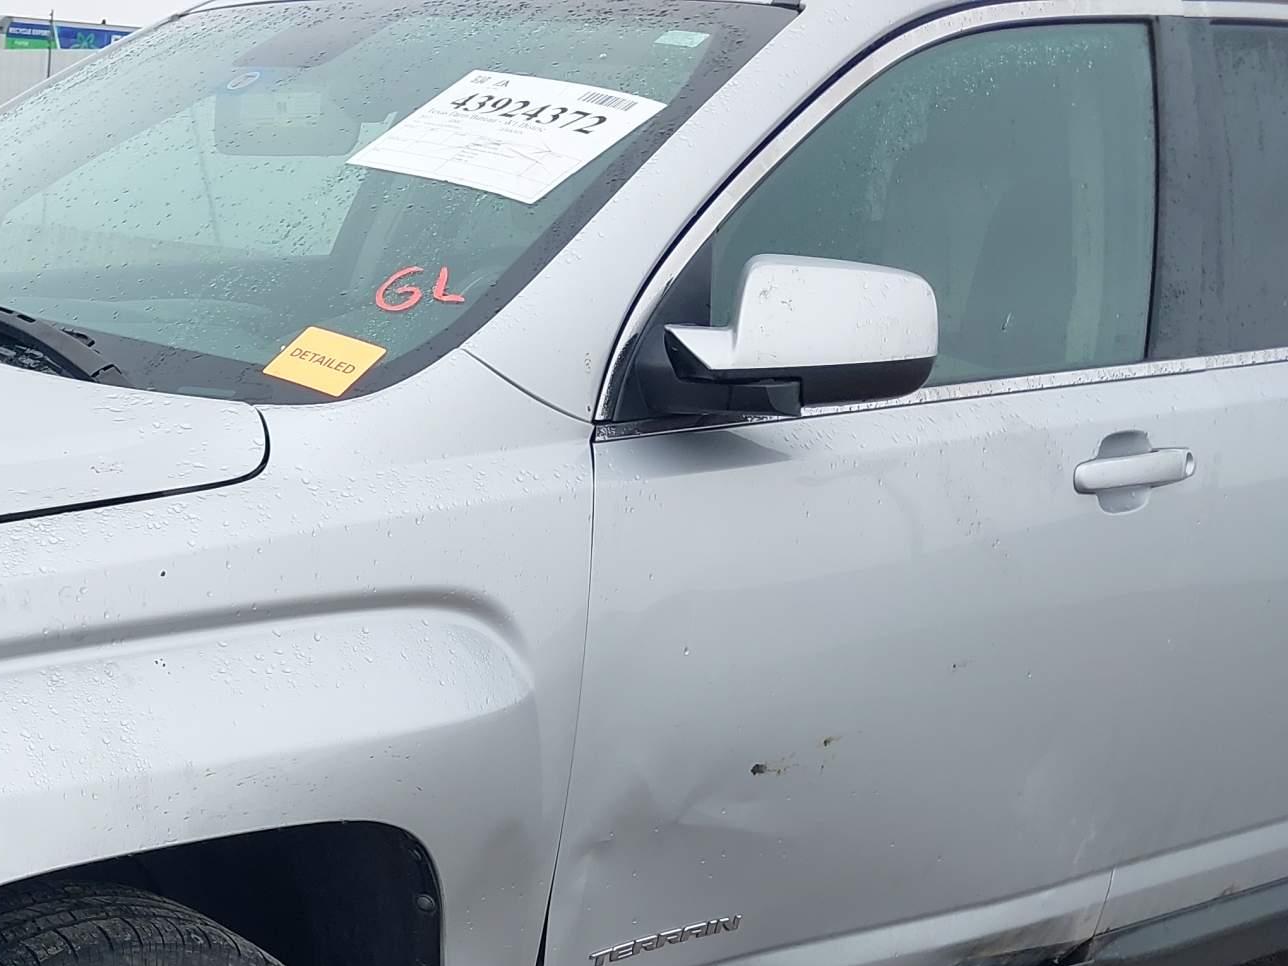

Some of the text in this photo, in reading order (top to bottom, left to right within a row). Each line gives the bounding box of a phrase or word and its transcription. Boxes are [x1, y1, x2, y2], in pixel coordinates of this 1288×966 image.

[450, 92, 608, 135] 43924372
[375, 266, 465, 312] GL
[290, 347, 356, 375] DETAILED
